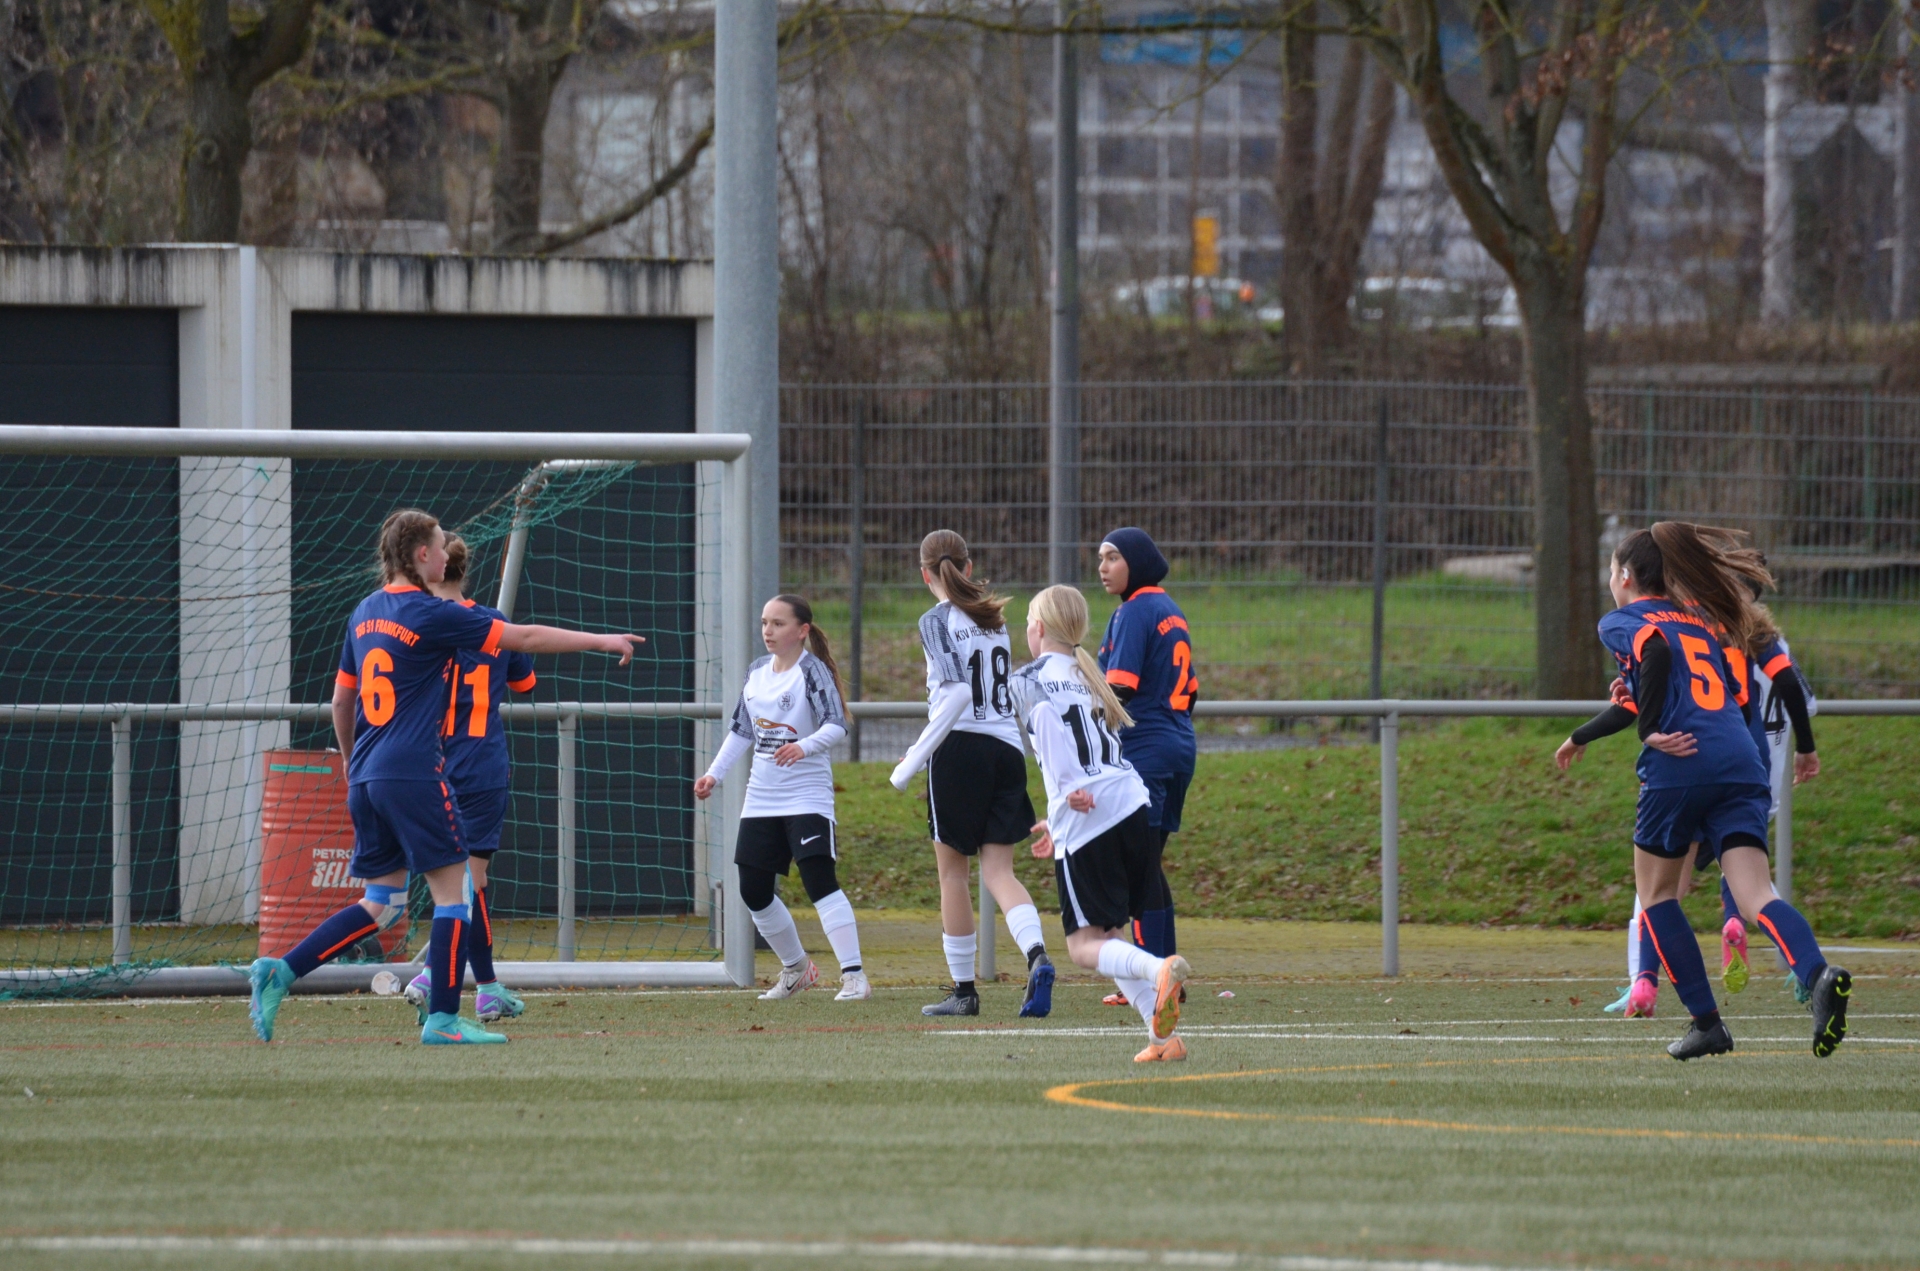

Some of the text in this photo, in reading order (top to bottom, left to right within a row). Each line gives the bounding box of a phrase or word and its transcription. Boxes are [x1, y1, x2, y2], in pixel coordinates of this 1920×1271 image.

[374, 618, 420, 647] FRANKFURT
[955, 627, 970, 642] KSV
[360, 647, 396, 726] 6
[967, 645, 1014, 720] 18
[1169, 640, 1191, 710] 2
[1678, 633, 1725, 711] 5
